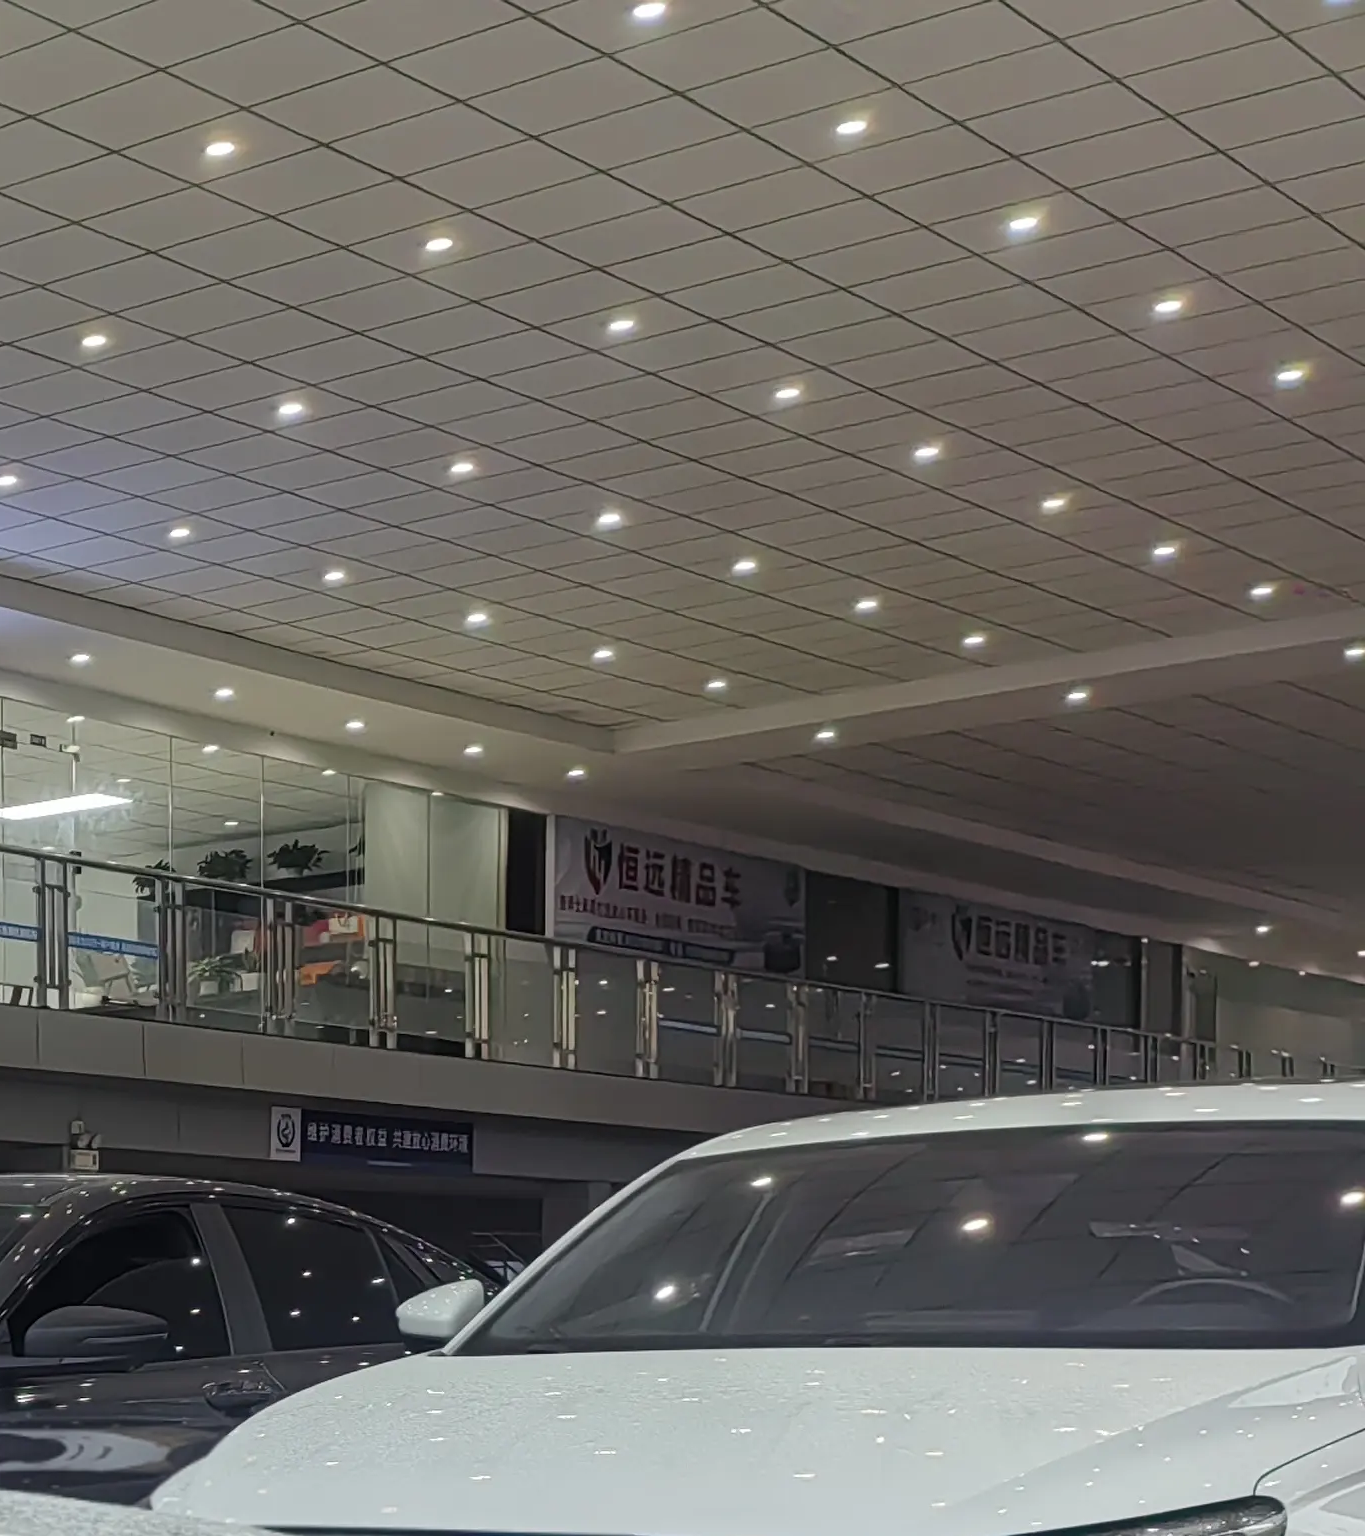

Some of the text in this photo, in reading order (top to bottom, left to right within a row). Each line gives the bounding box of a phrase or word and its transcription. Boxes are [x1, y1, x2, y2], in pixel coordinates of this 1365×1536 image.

[618, 842, 742, 910] 恒远精品车
